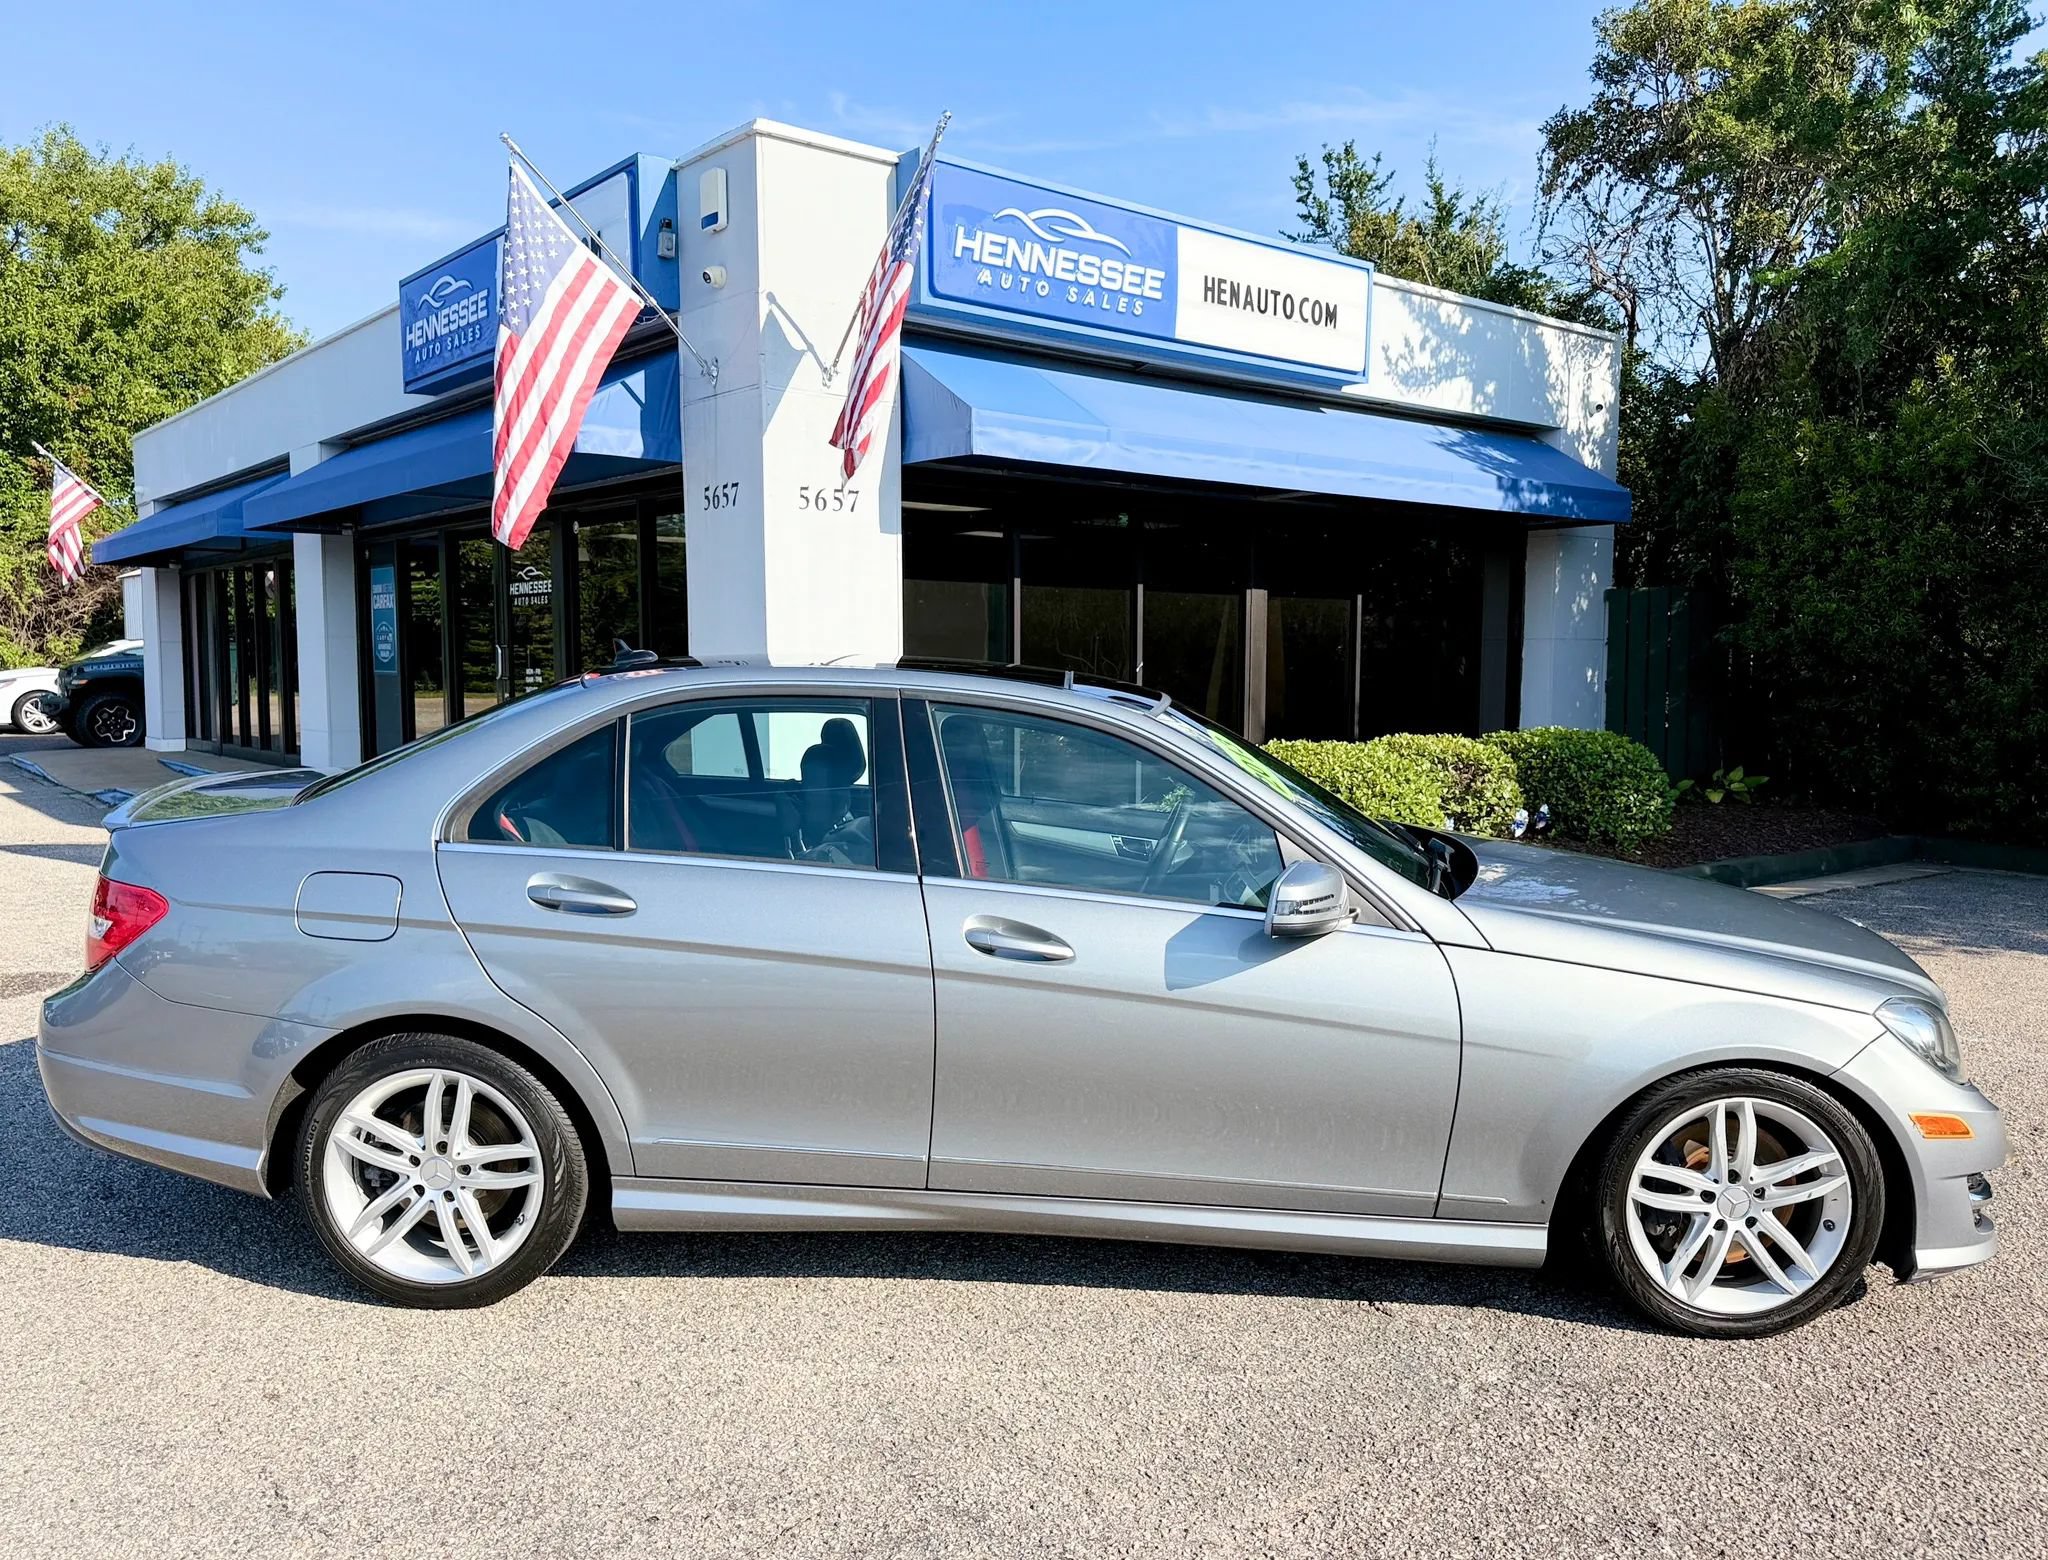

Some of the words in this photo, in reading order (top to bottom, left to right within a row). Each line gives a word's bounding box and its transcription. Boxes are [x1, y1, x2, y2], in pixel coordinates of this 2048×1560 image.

[953, 224, 1165, 300] HENNESSEE
[977, 268, 1050, 297] AUTO
[1067, 285, 1144, 316] SALES
[406, 289, 488, 351] HENNESSEE
[414, 342, 441, 364] AUTO
[447, 324, 481, 350] SALES
[703, 482, 740, 511] 5657
[799, 485, 860, 513] 5657
[373, 593, 394, 609] CARFAX
[509, 580, 553, 595] HENNESSEE
[514, 597, 529, 606] AUTO
[530, 595, 549, 605] SALES
